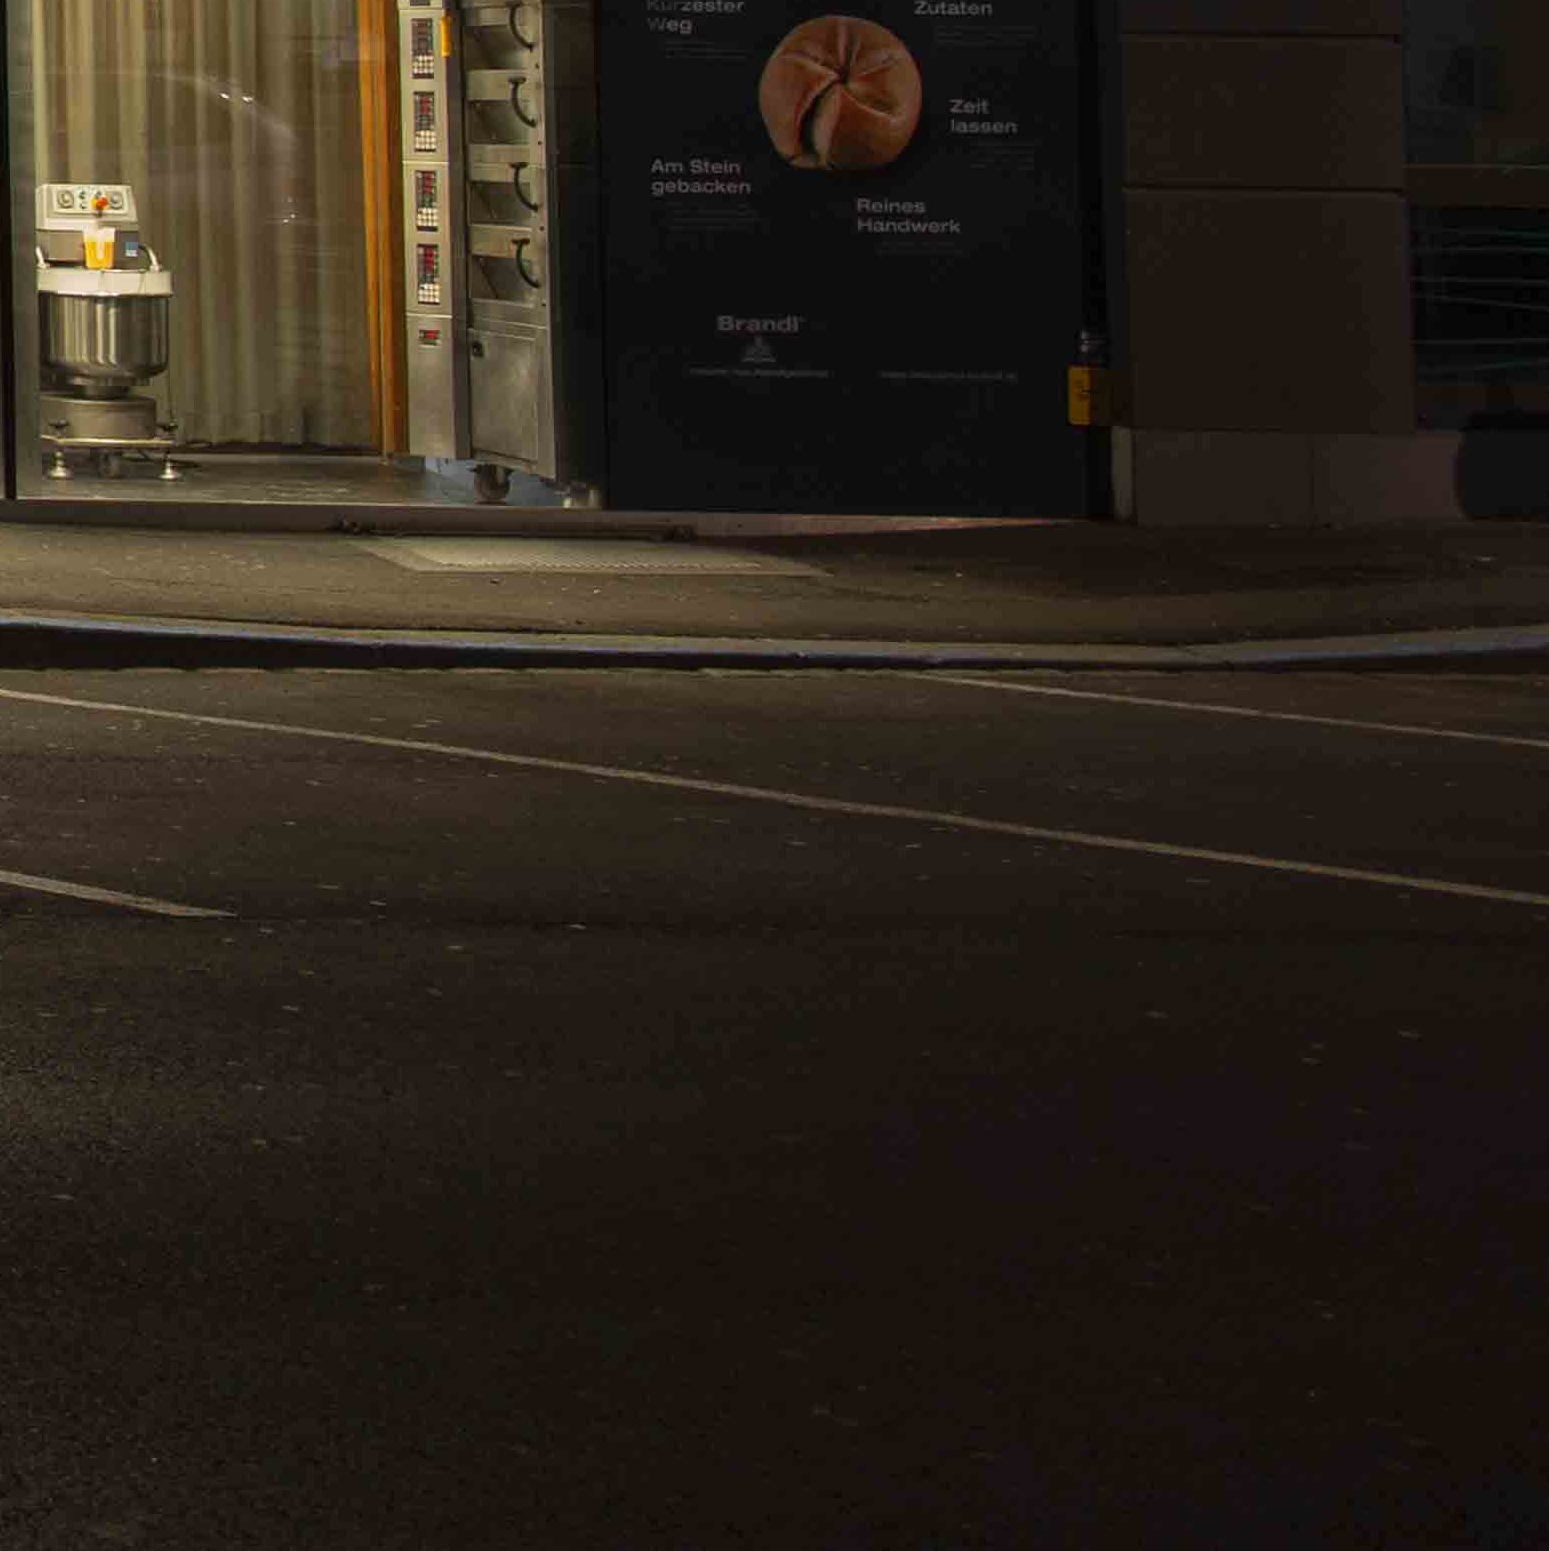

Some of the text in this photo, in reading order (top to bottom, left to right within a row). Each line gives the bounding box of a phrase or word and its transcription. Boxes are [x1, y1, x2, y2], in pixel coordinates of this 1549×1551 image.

[913, 0, 993, 17] Zutaten
[647, 17, 693, 35] Weg
[949, 99, 990, 115] Zeit
[950, 119, 1018, 136] lassen
[651, 159, 742, 175] Am Stein
[651, 178, 752, 197] gebacken
[856, 198, 927, 215] Reines
[856, 217, 961, 235] Handwerk
[717, 315, 800, 334] Brandl
